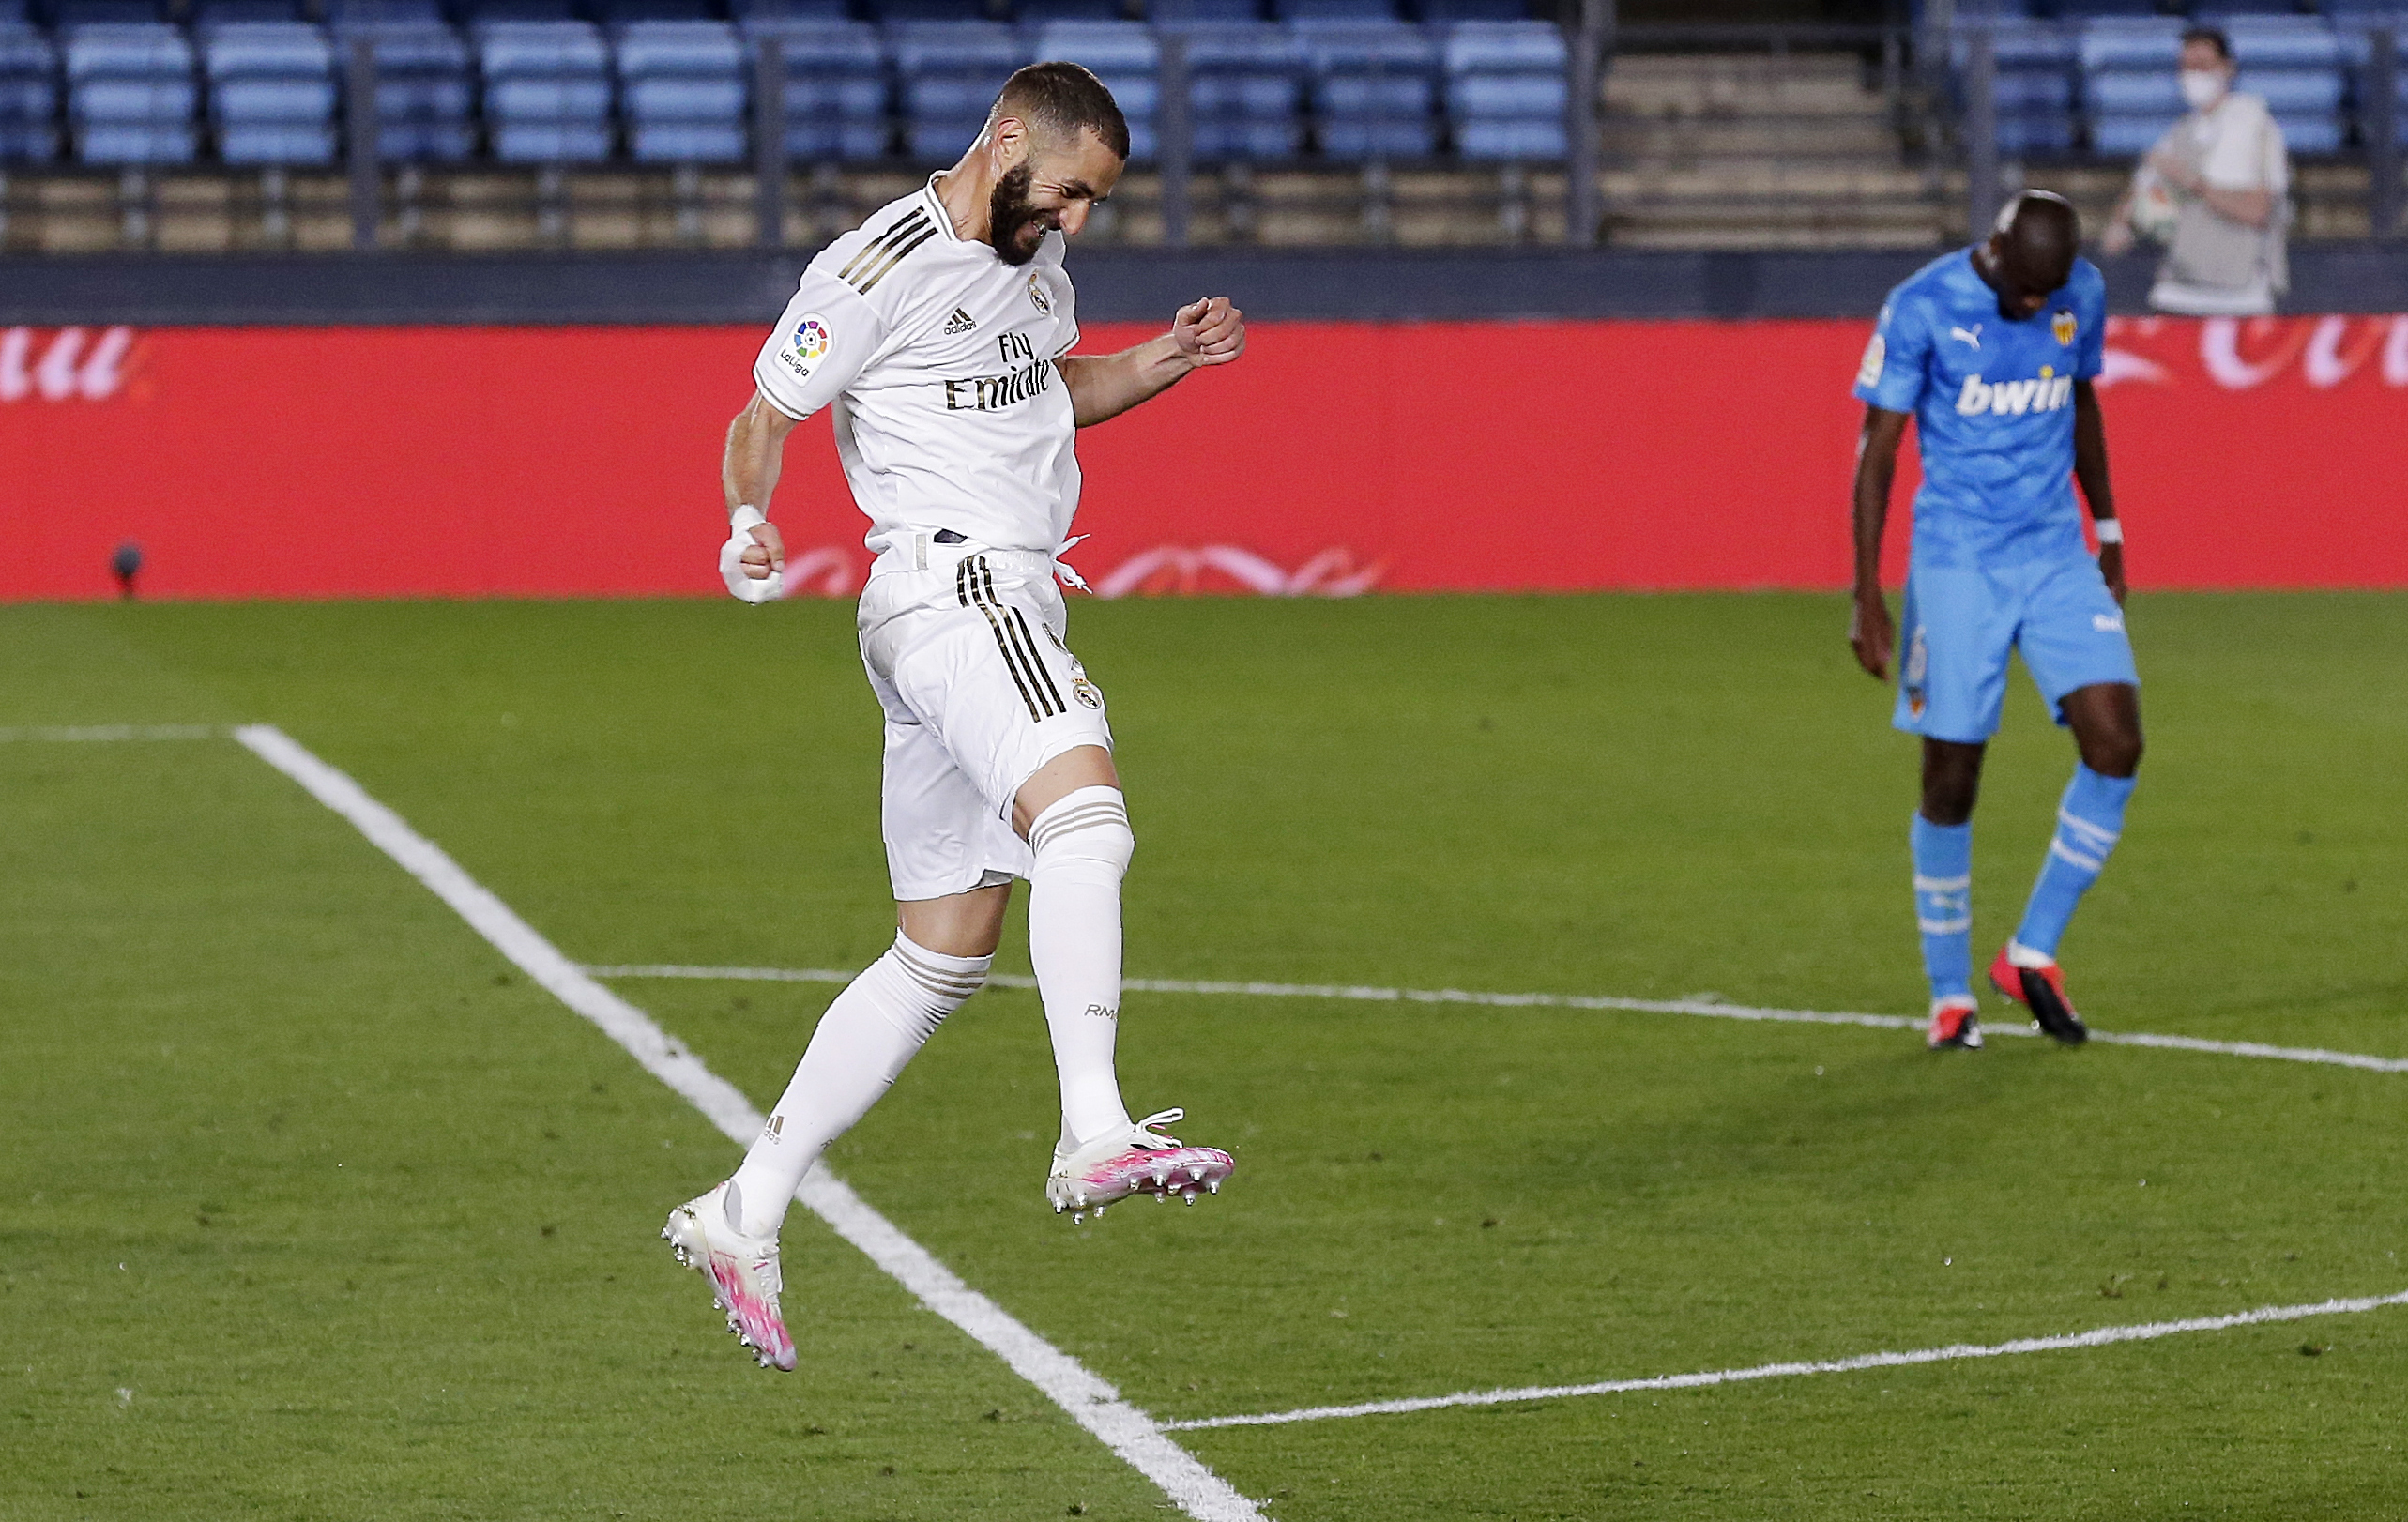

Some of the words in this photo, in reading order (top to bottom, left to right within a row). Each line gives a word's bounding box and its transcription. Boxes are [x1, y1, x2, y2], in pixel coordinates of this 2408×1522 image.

[943, 321, 977, 335] adidas
[998, 332, 1034, 363] Fly
[780, 348, 810, 377] LaLiga
[1955, 365, 2073, 416] bwin
[1084, 1003, 1117, 1021] RM
